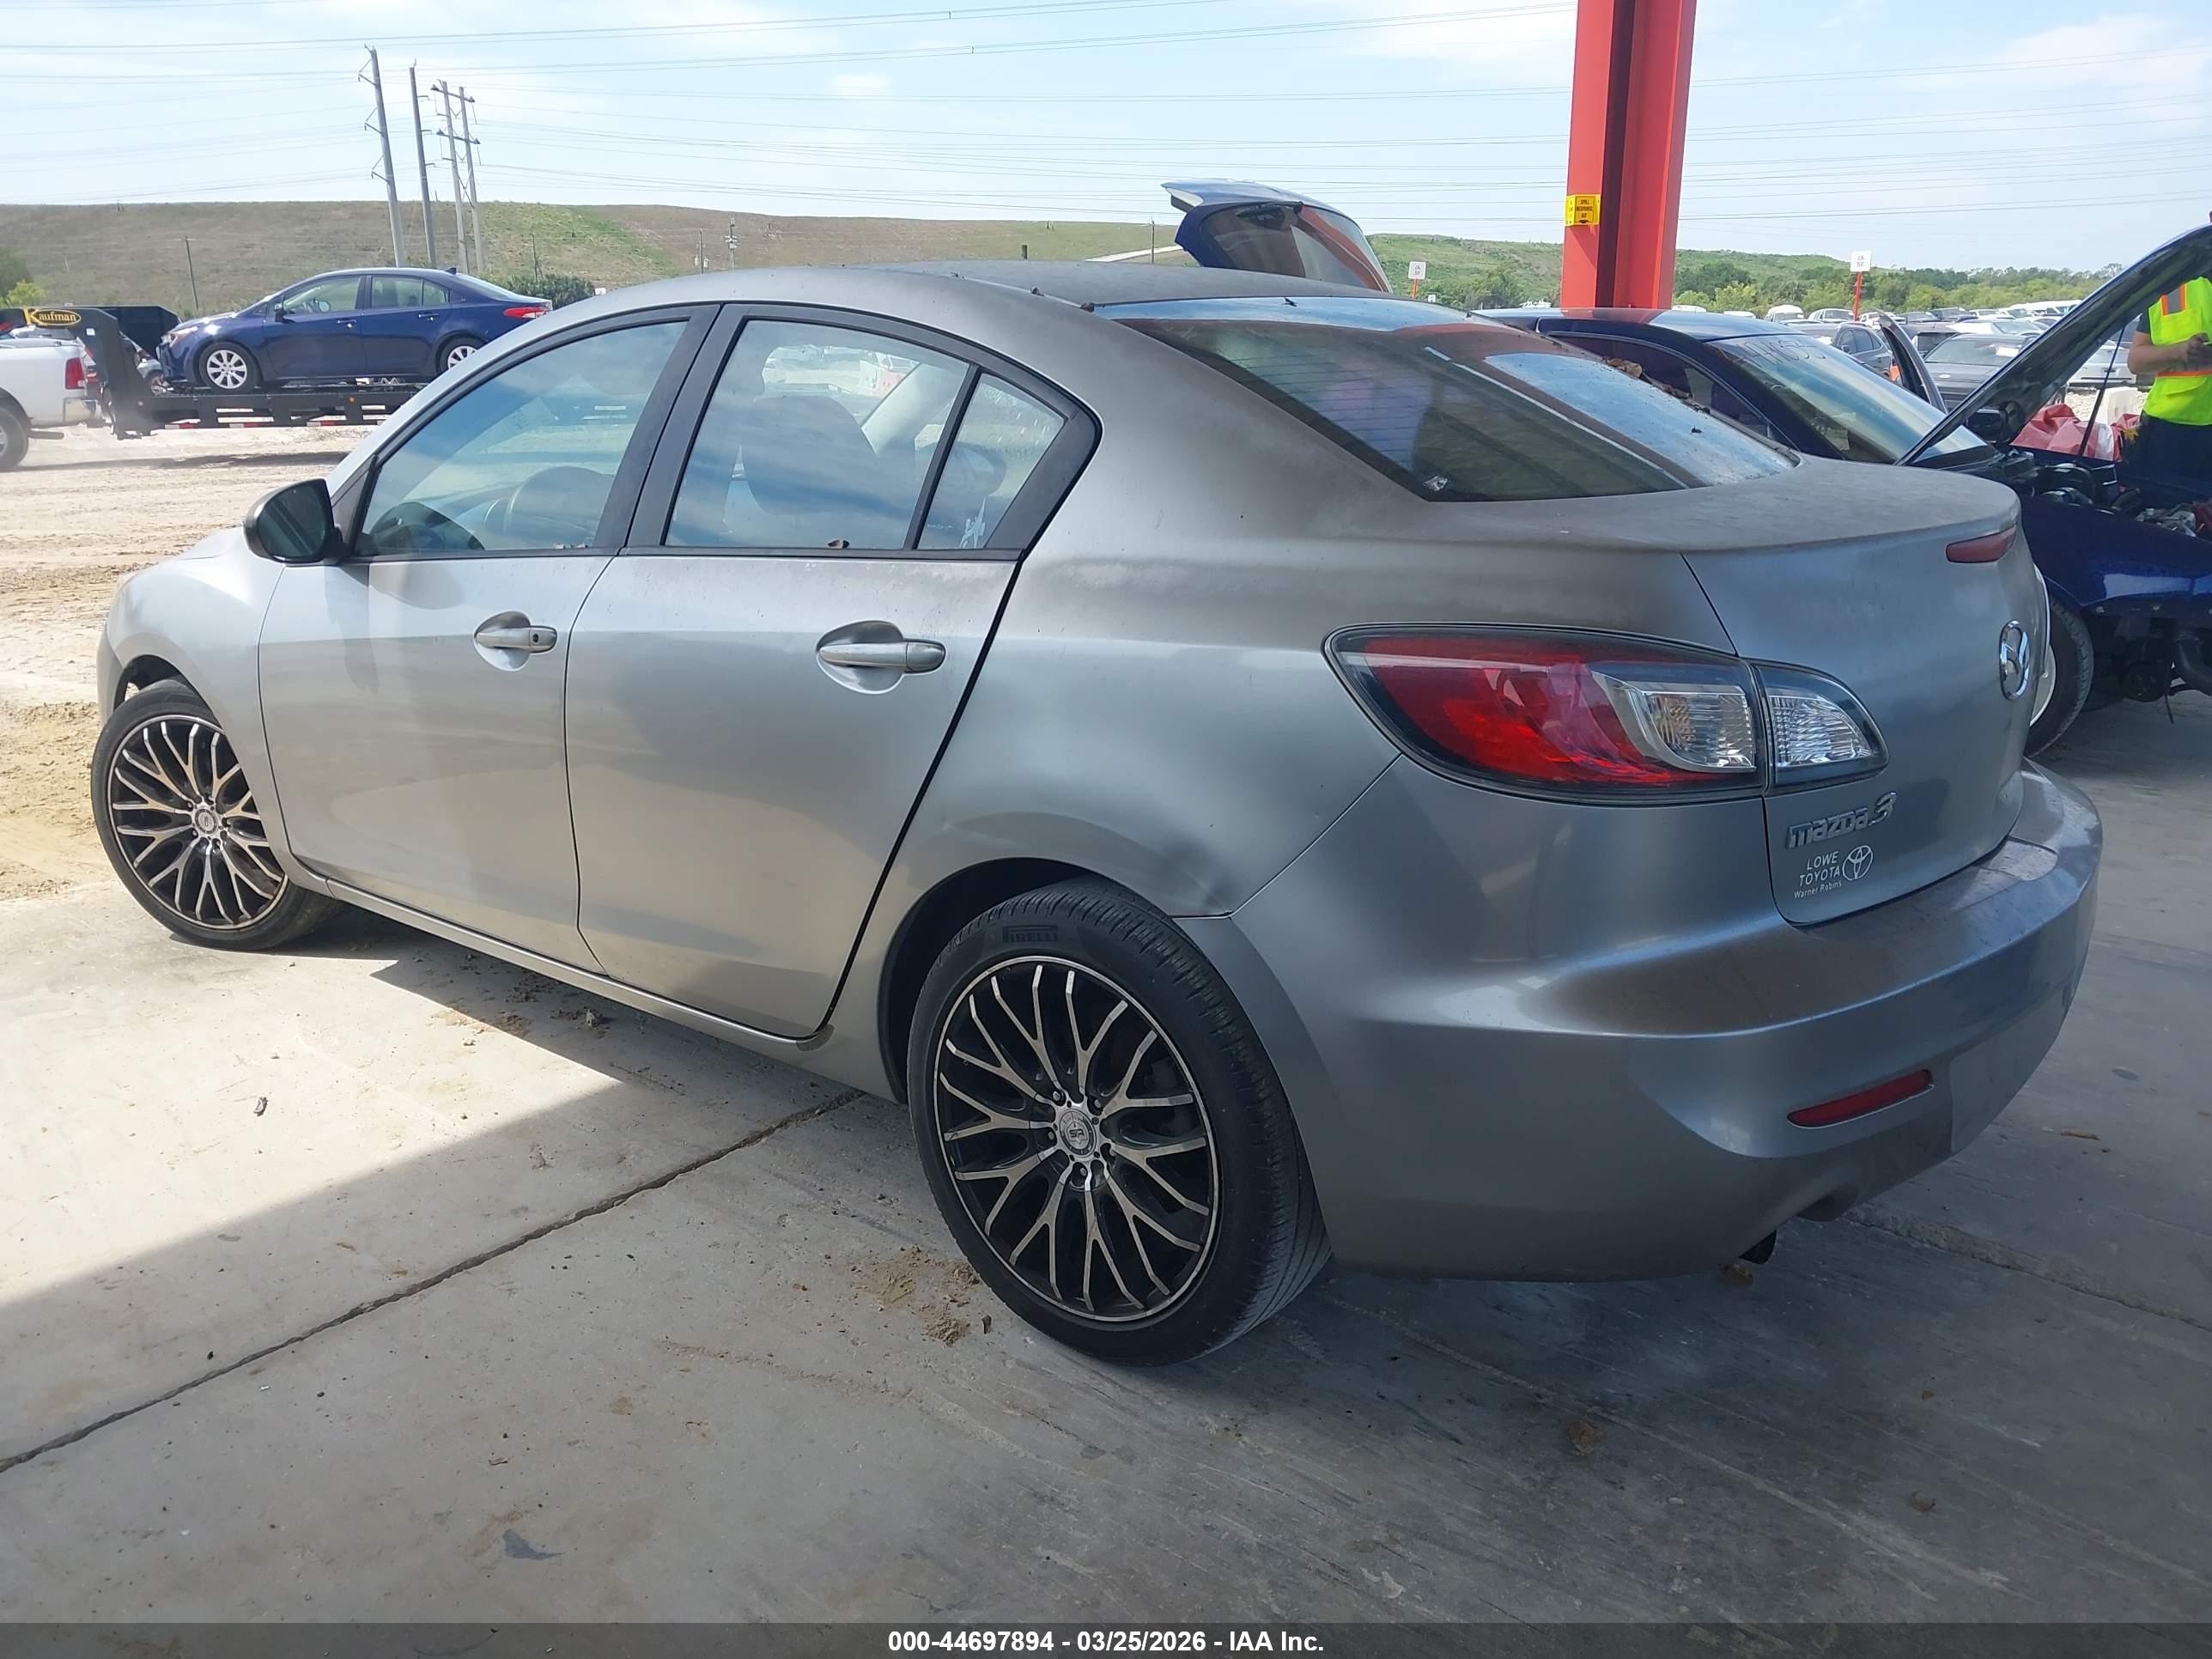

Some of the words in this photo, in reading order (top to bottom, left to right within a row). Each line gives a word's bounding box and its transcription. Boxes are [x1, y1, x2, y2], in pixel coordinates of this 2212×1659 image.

[24, 307, 76, 325] Kaufman
[1807, 851, 1839, 871] LOWE
[1799, 866, 1841, 887] TOYOTA
[1794, 886, 1820, 900] Warner
[1820, 880, 1842, 894] Robins
[1003, 924, 1059, 943] PIRELLI
